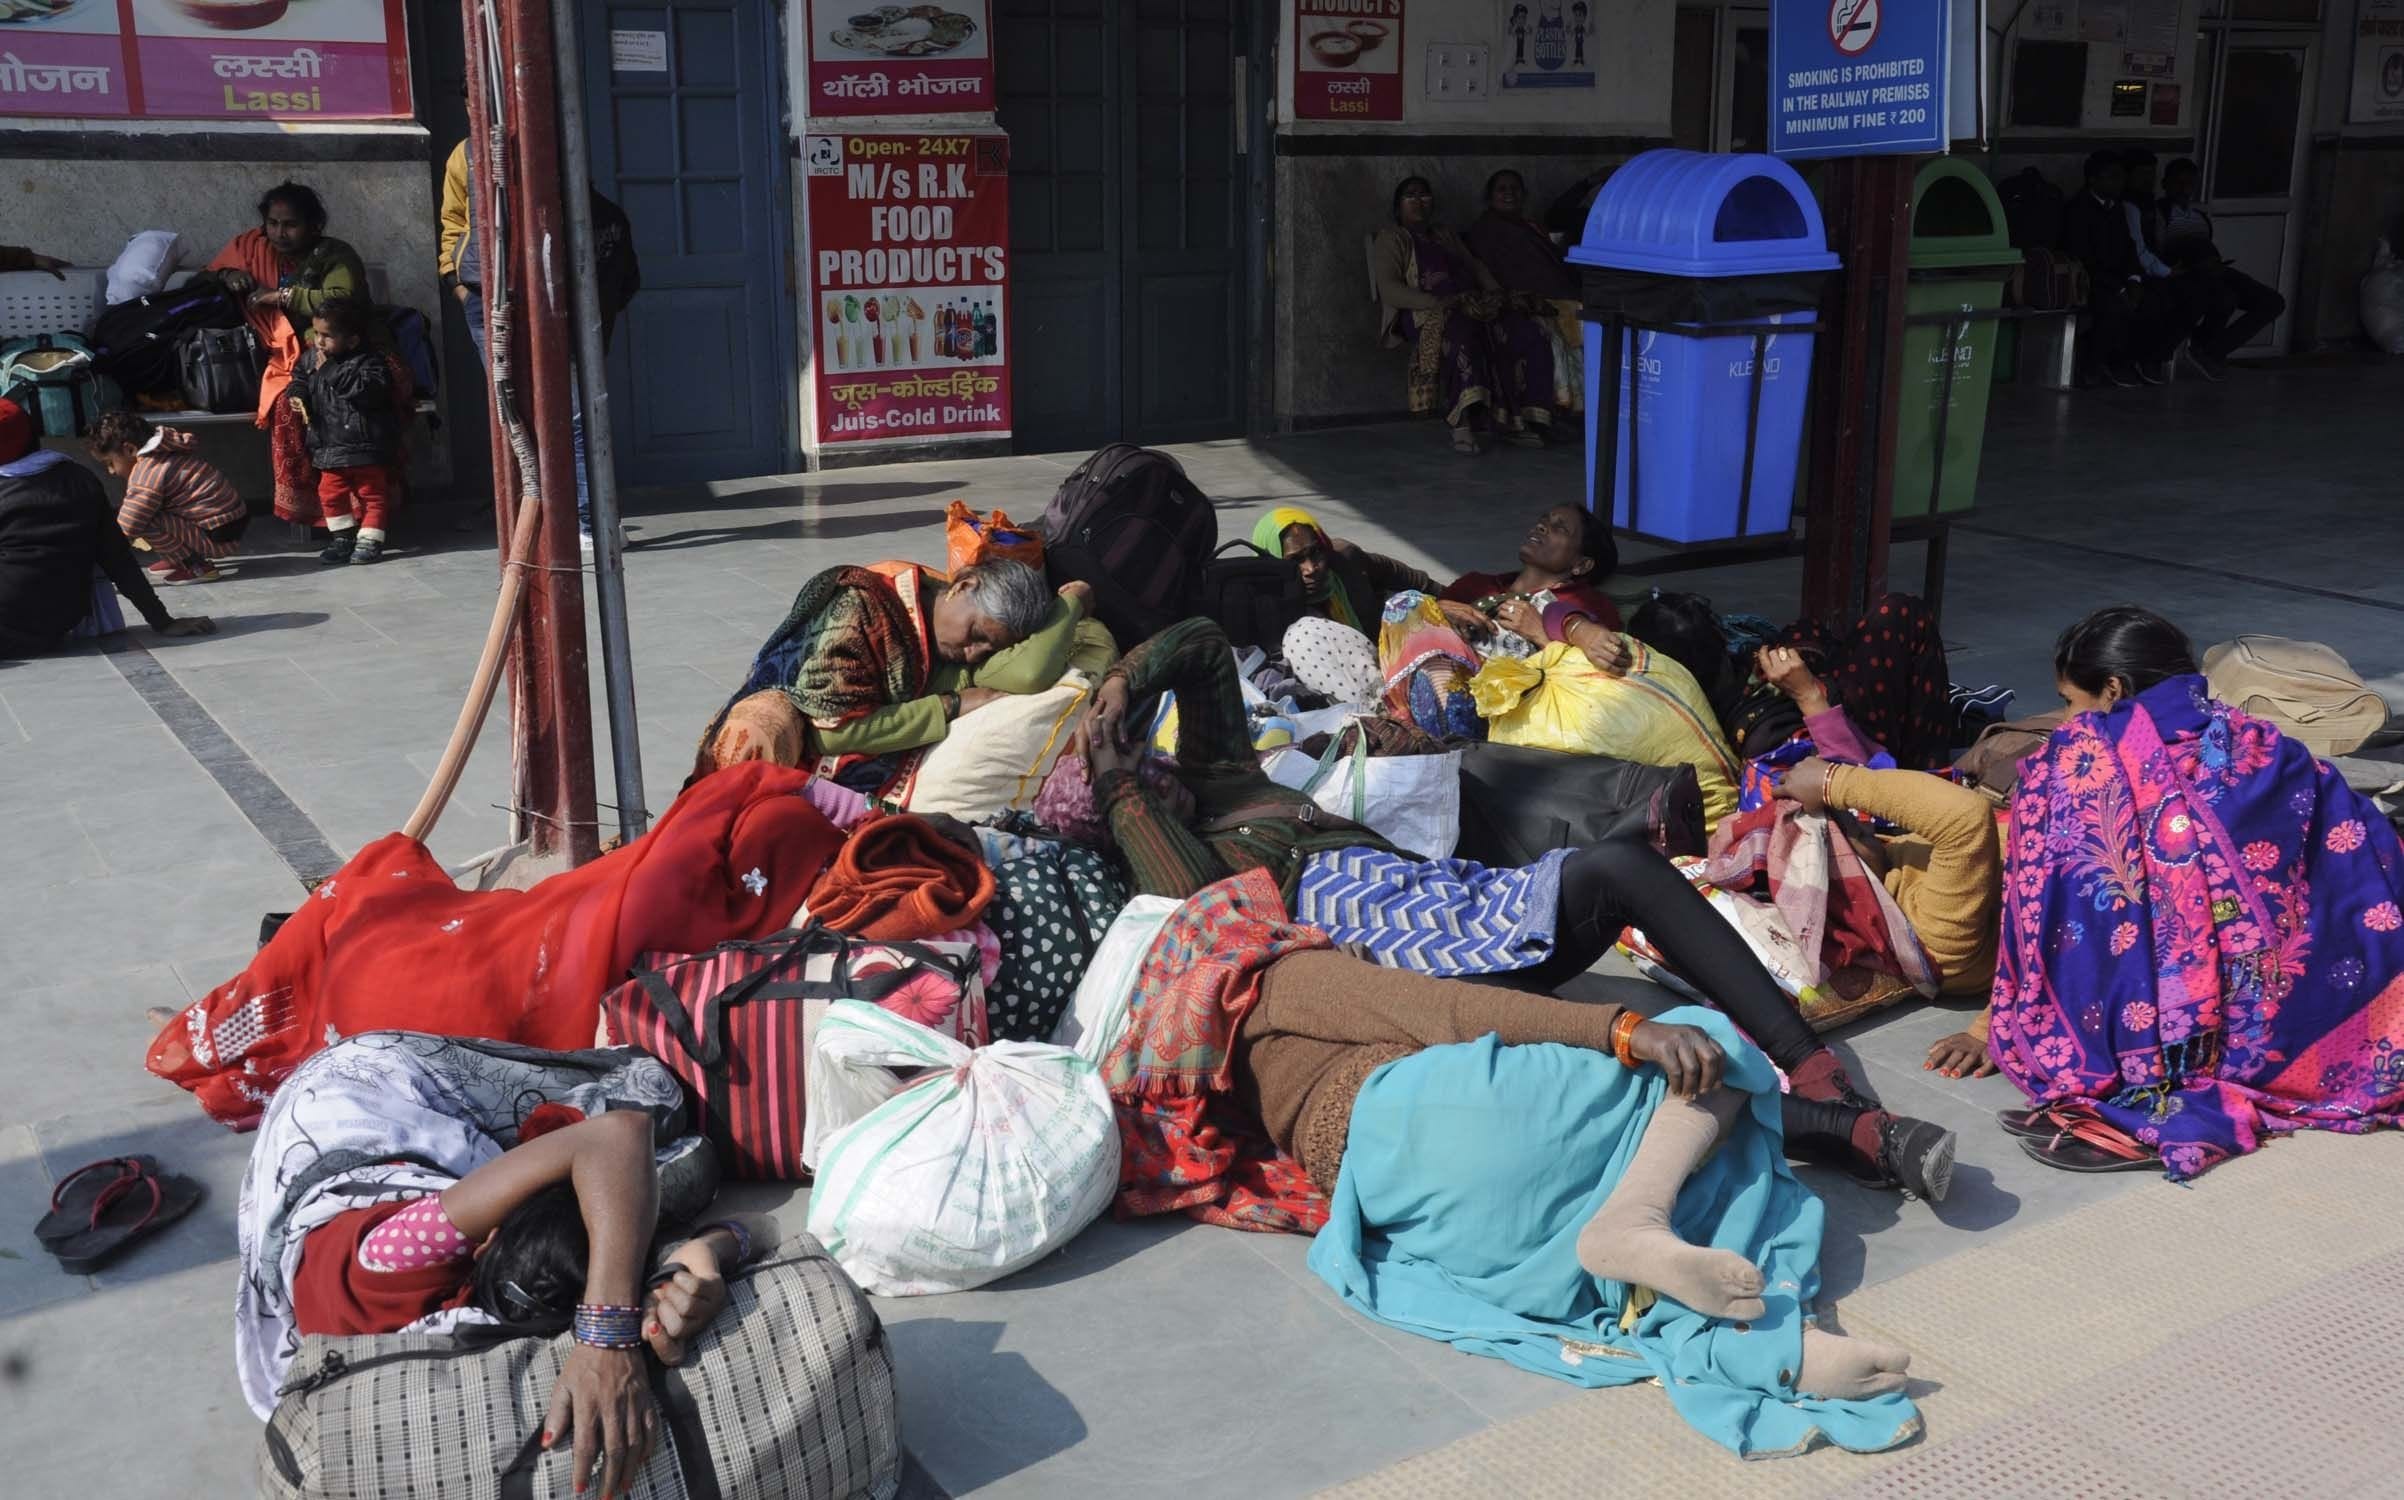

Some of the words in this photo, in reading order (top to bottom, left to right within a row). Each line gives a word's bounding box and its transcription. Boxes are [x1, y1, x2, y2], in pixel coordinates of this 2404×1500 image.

[1299, 0, 1401, 15] PRODUCTS
[210, 48, 322, 79] लस्सी
[1788, 68, 1839, 89] SMOKING
[1841, 66, 1852, 83] IS
[1854, 58, 1925, 81] PROHIBITED
[223, 84, 321, 112] Lassi
[822, 72, 891, 98] थॉली
[897, 72, 983, 96] भोजन
[1327, 76, 1371, 95] लस्सी
[1783, 97, 1794, 113] IN
[1797, 93, 1818, 112] THE
[1820, 89, 1869, 110] RAILWAY
[1872, 82, 1930, 105] PREMISES
[1329, 97, 1370, 113] Lassi
[1785, 115, 1849, 135] MINIMUM
[1853, 111, 1887, 129] FINE
[848, 137, 912, 159] Open-
[918, 138, 971, 156] 24X7
[814, 166, 841, 176] IRCTC
[847, 162, 912, 200] M/s
[918, 163, 975, 199] R.K.
[871, 204, 953, 242] FOOD
[819, 246, 1006, 286] PRODUCT'S
[830, 406, 936, 432] Juis-Cold
[943, 403, 1001, 424] Drink
